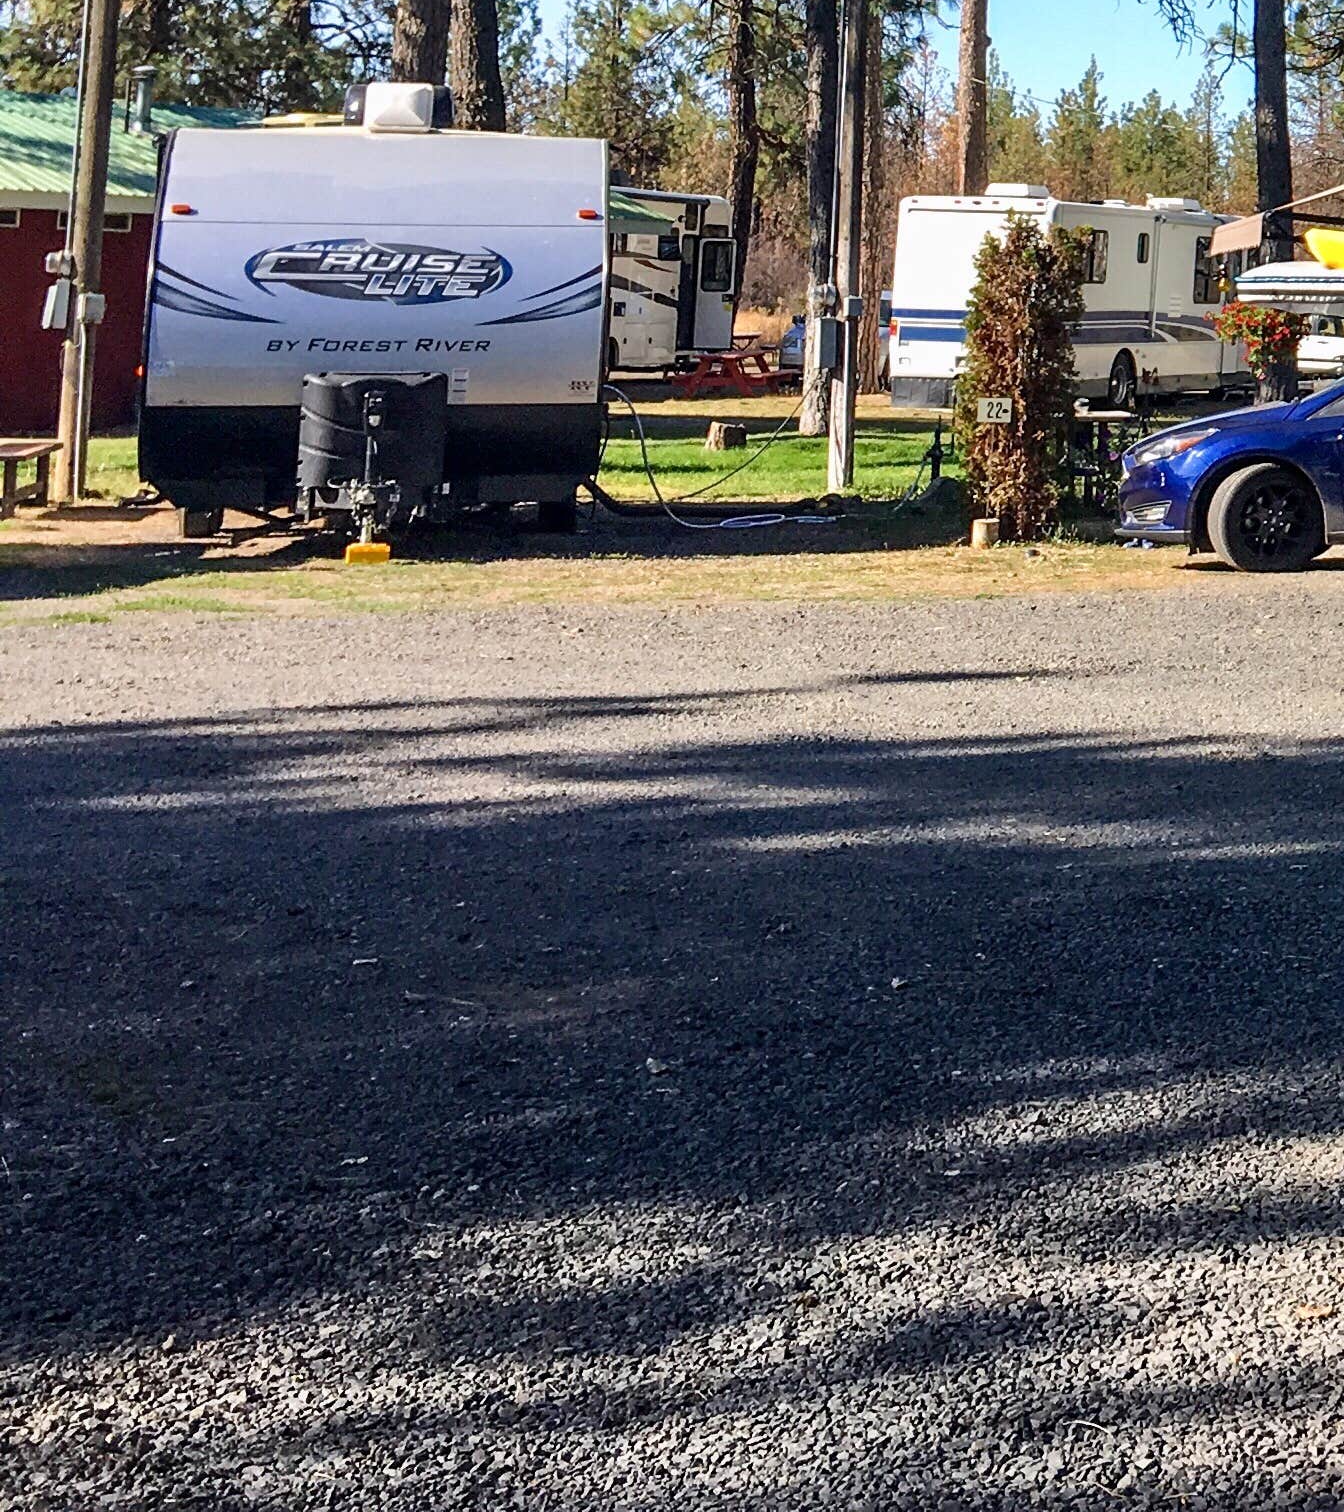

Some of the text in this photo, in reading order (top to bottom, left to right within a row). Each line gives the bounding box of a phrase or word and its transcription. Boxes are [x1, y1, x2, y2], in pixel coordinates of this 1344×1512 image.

[292, 244, 372, 253] SALEM
[252, 252, 497, 281] CRUISE
[363, 274, 486, 296] LITE
[266, 338, 491, 352] BY FOREST RIVER
